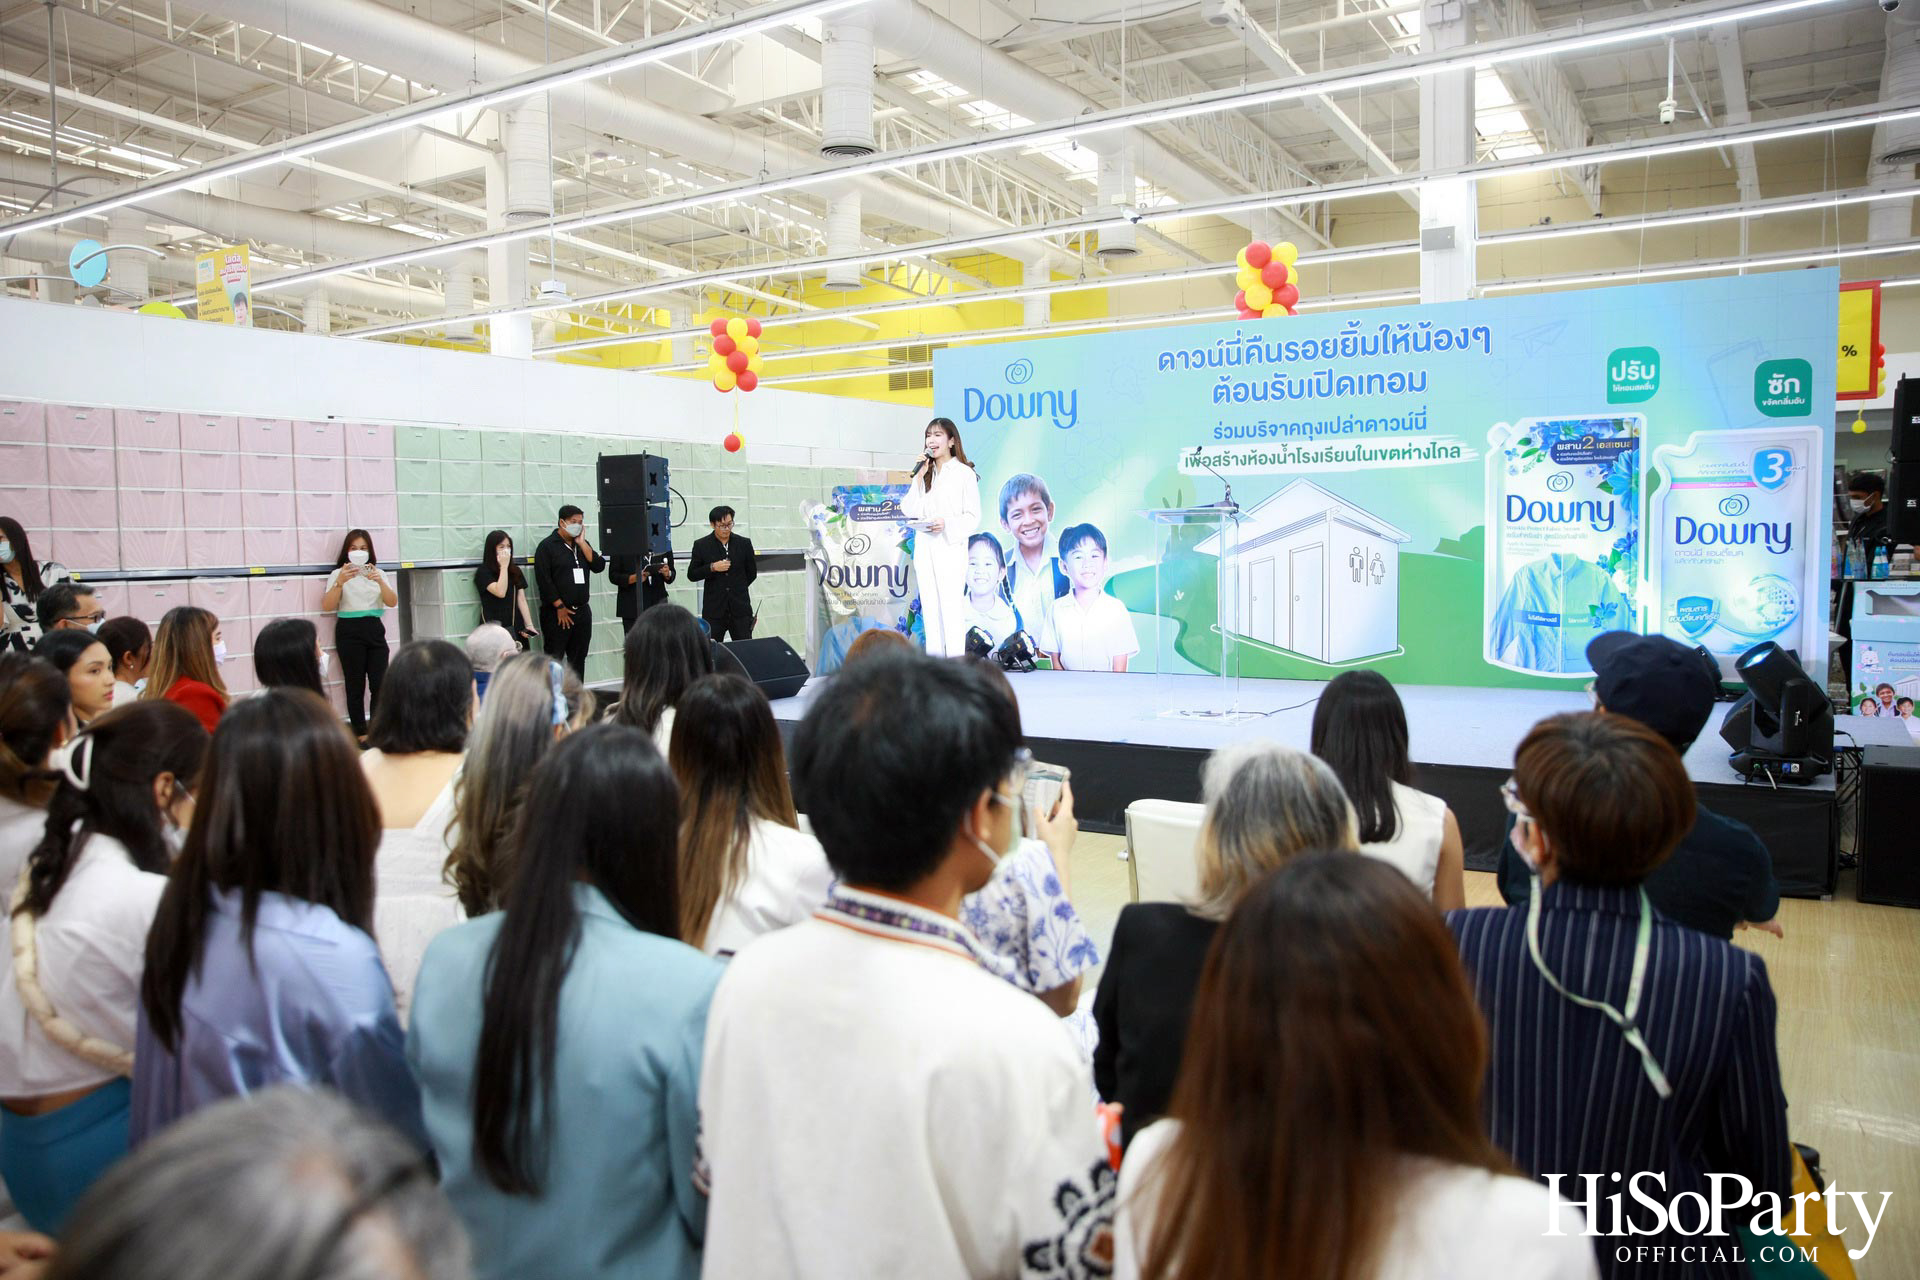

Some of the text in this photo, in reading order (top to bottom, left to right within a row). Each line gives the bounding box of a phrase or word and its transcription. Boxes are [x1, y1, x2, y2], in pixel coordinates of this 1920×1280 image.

[1158, 320, 1491, 371] ดาวน์นี่คืนรอยยิ้มให้น้องๆ
[1841, 345, 1858, 357] %
[1212, 368, 1427, 404] ต้อนรับเปิดเทอม
[1611, 360, 1655, 382] ปรับ
[1768, 373, 1800, 395] ซัก
[963, 387, 1077, 428] Downy
[1213, 406, 1427, 441] ร่วมบริจาคถุงเปล่าดาวน์นี่
[1184, 442, 1461, 468] เพื่อสร้างห้องน้ำโรงเรียนในเขตห่างไกล
[1582, 436, 1594, 449] 2
[1761, 453, 1785, 483] 3
[882, 501, 892, 511] 2
[1506, 494, 1615, 531] Downy
[1675, 516, 1792, 554] Downy
